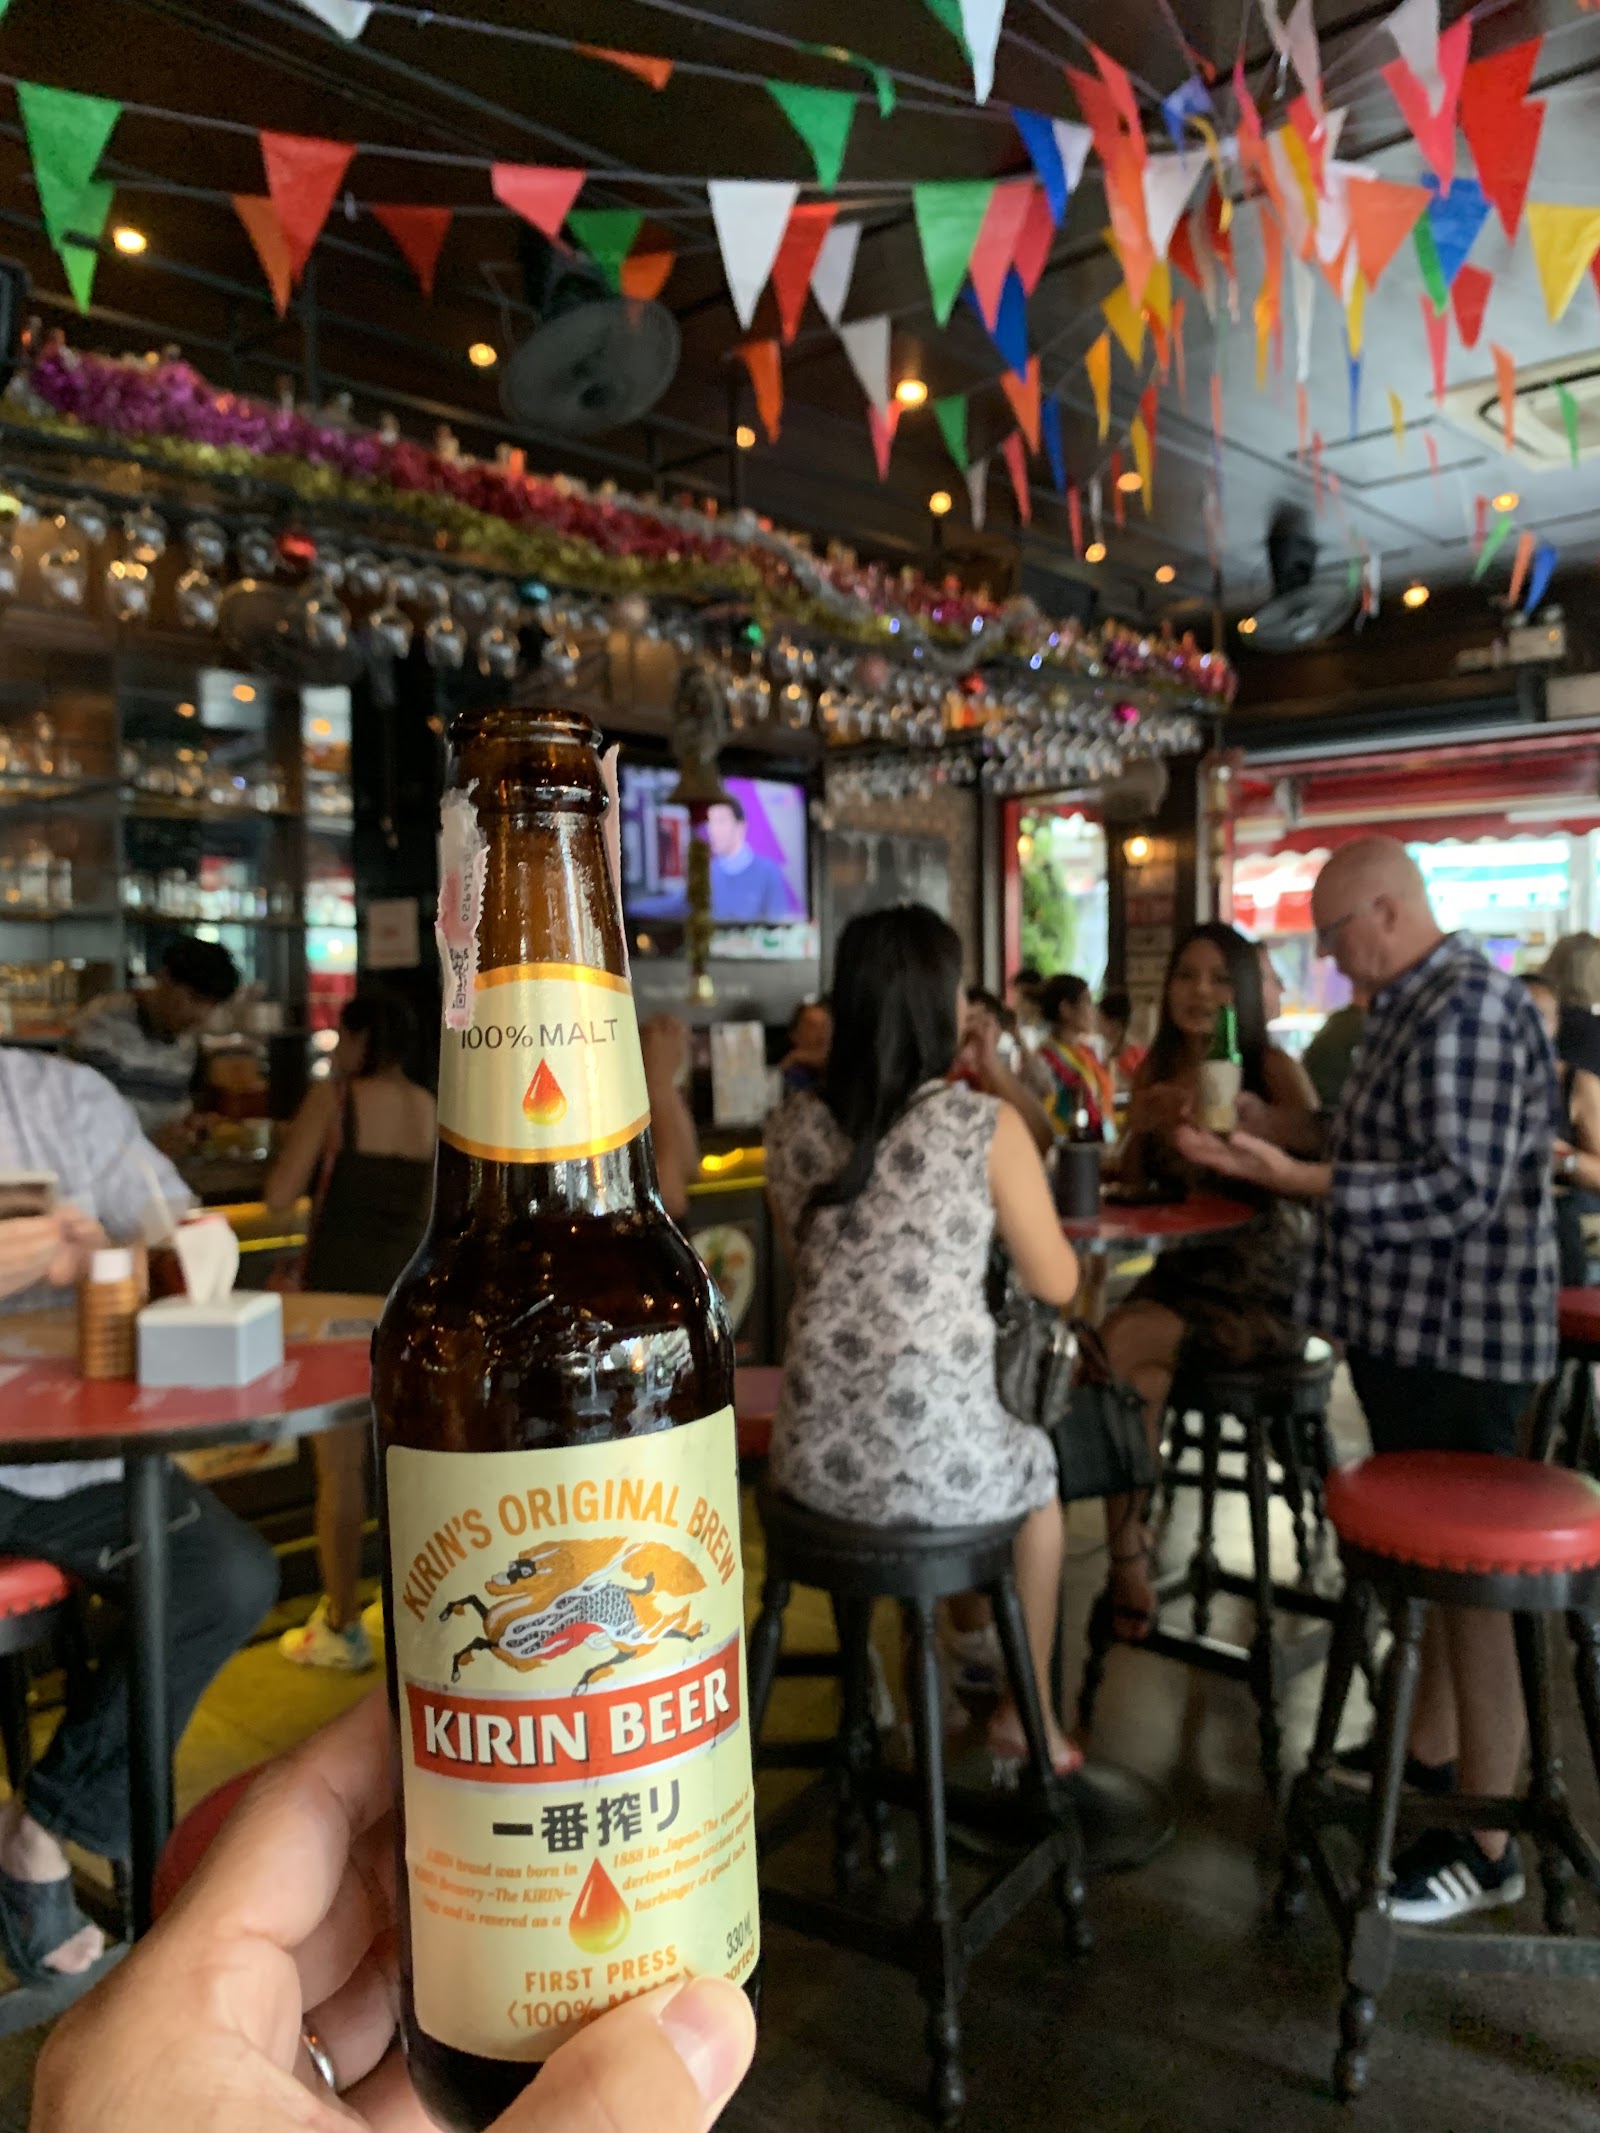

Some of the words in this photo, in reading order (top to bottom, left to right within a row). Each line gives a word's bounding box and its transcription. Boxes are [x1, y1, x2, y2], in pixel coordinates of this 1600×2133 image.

[461, 1025, 533, 1050] 100%
[539, 1018, 618, 1047] MALT
[402, 1508, 493, 1622] KIRIN'S
[498, 1478, 679, 1536] ORIGINAL
[686, 1496, 736, 1585] BREW
[423, 1704, 589, 1767] KIRIN
[609, 1667, 731, 1755] BEER
[492, 1779, 681, 1854] 一番搾り
[526, 1863, 560, 1878] born
[563, 1861, 578, 1876] in
[647, 1845, 660, 1859] in
[525, 1967, 593, 1993] FIRST
[606, 1944, 678, 1985] PRESS
